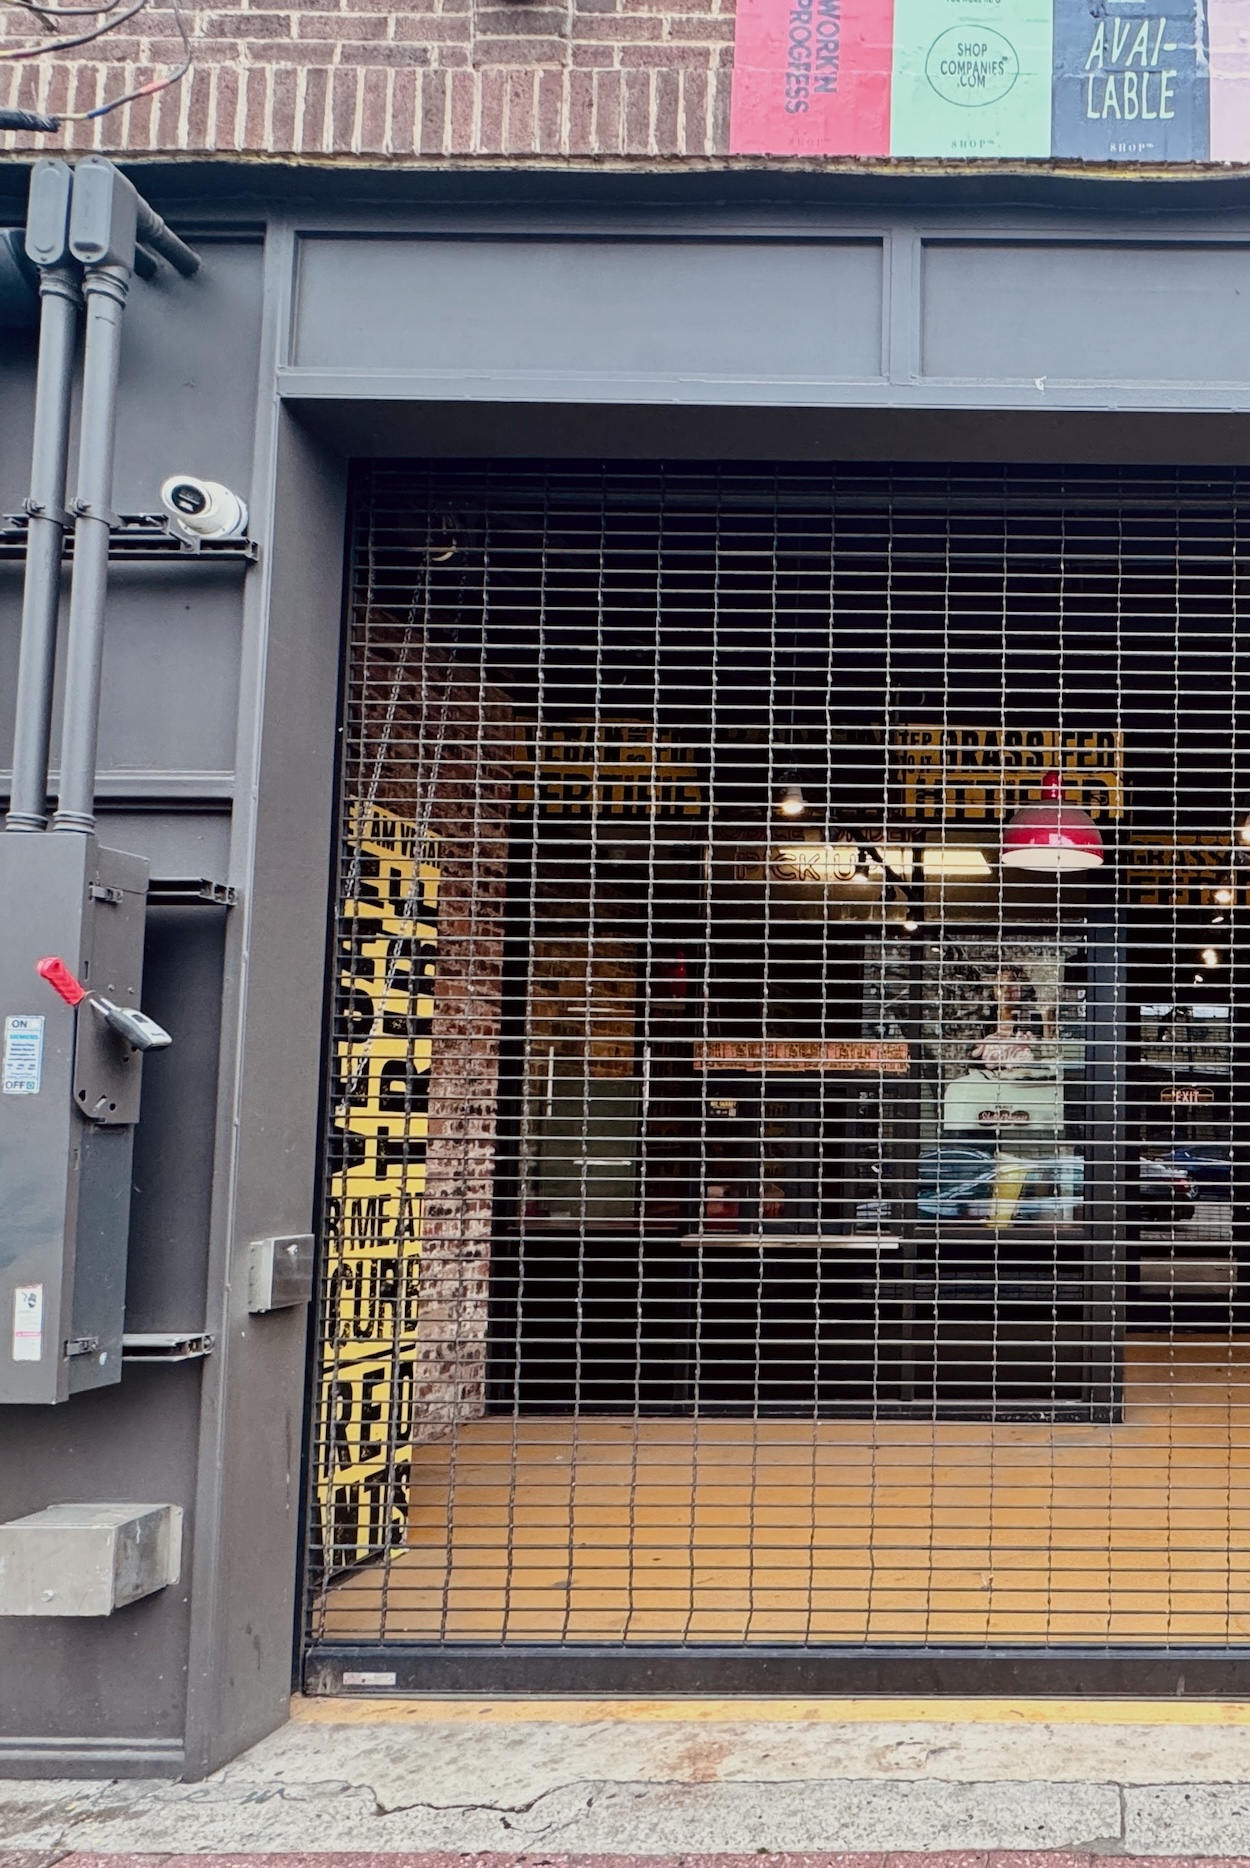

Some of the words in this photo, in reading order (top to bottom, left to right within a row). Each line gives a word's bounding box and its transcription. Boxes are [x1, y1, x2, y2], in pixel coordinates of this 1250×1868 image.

[957, 43, 988, 57] SHOP
[1085, 17, 1178, 71] AVAI-
[940, 60, 1005, 76] COMPANIES
[956, 74, 987, 88] .COM
[1087, 70, 1177, 120] LABLE
[1062, 730, 1115, 774] FED
[12, 1019, 28, 1028] ON
[5, 1080, 26, 1089] OFF
[1175, 1090, 1200, 1104] EXIT
